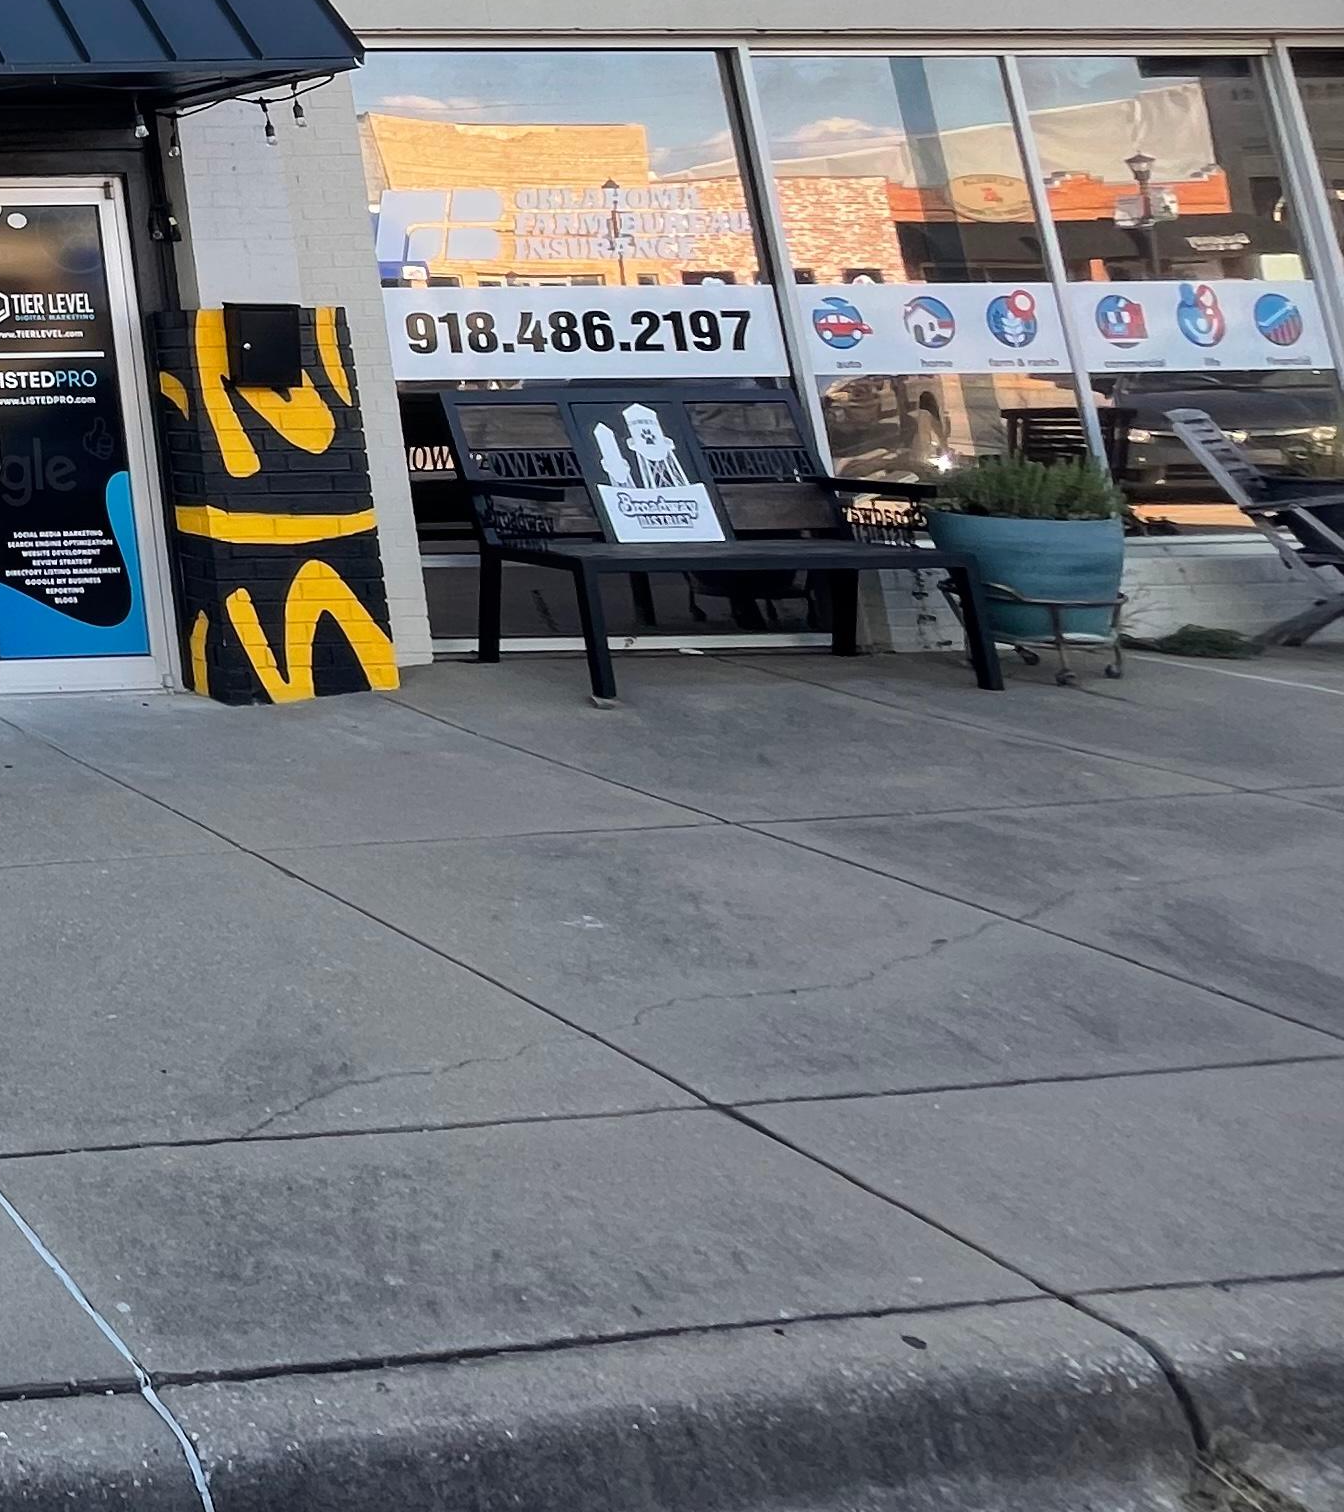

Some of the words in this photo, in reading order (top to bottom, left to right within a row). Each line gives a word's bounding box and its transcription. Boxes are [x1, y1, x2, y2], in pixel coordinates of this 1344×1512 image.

[514, 187, 702, 210] OKLAHOMA
[513, 212, 608, 236] FARM
[618, 211, 752, 236] BUREAU
[513, 235, 698, 260] INSURANCE
[11, 293, 45, 314] TIER
[48, 293, 94, 313] LEVEL
[406, 309, 752, 354] 918.486.2197
[617, 492, 698, 520] Broadway
[13, 531, 38, 539] SOCIAL
[39, 530, 62, 538] MEDIA
[62, 529, 103, 537] MARKETING
[35, 540, 62, 548] ENGINE
[62, 539, 113, 547] OPTIMIZATION
[51, 548, 101, 557] DEVELOPMENT
[59, 558, 93, 566] STRATEGY
[5, 569, 43, 577] DIRECTORY
[43, 568, 72, 576] LISTING
[72, 567, 121, 575] MANAGEMENT
[25, 578, 55, 586] GOOGLE
[54, 596, 78, 604] BLOGS
